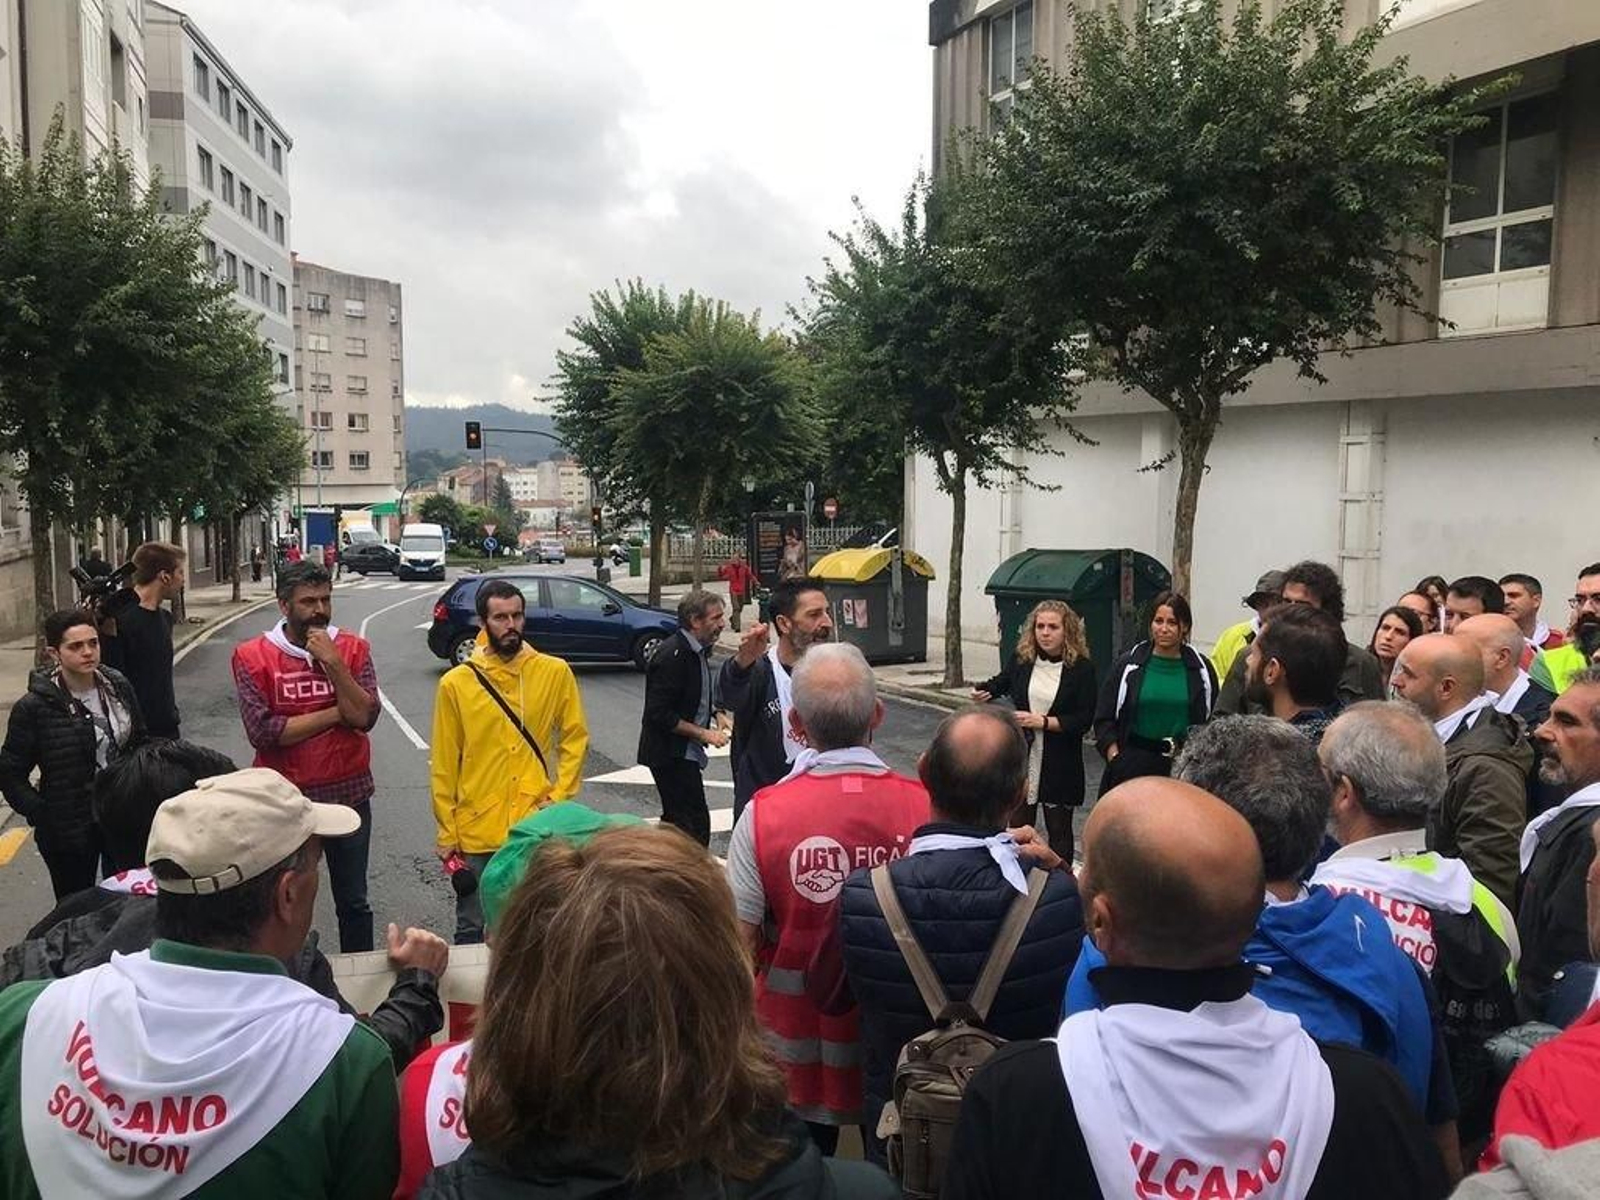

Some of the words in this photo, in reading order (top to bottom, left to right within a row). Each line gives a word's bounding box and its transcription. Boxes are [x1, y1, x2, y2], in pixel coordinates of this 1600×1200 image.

[282, 680, 334, 699] CCO
[797, 846, 841, 873] UGT
[65, 1020, 228, 1135] VULCANO
[48, 1083, 190, 1175] SOLUCIÓN
